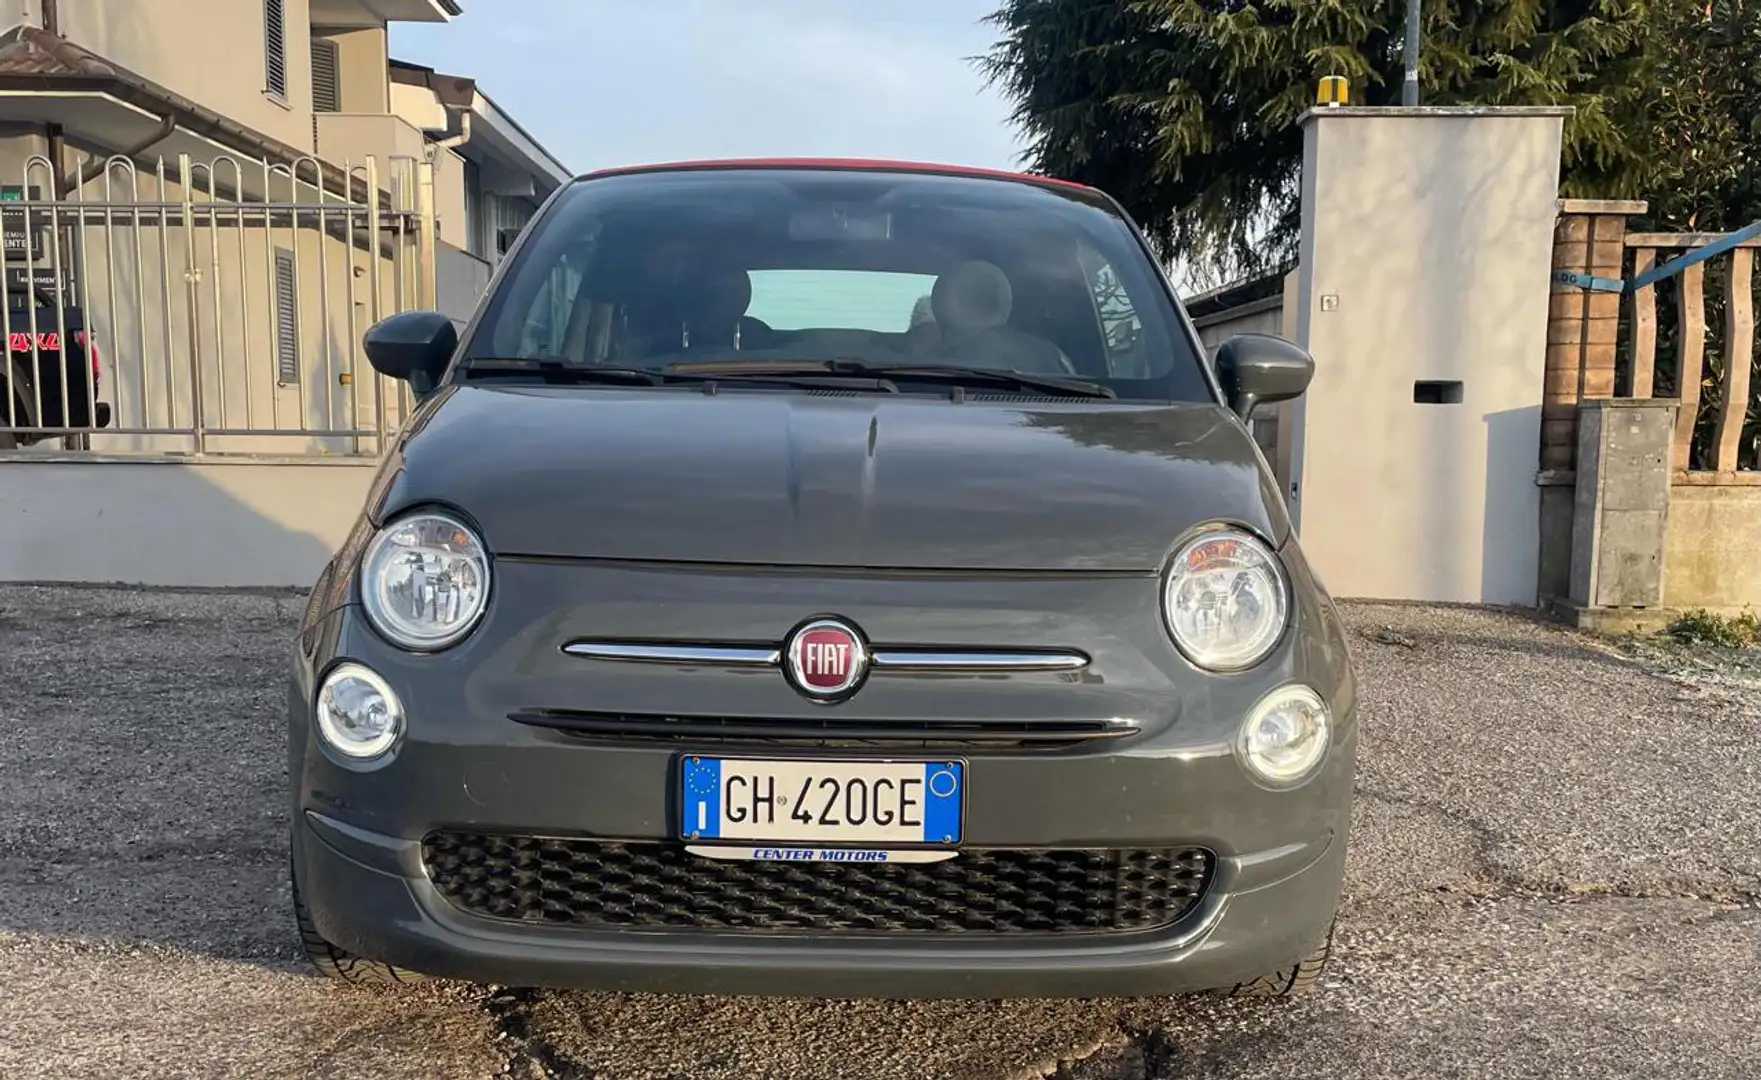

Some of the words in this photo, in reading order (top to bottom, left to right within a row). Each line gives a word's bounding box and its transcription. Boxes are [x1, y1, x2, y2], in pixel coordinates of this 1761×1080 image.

[806, 643, 849, 676] FIAT
[725, 775, 775, 824] GH
[791, 777, 922, 827] 420GE
[753, 848, 814, 860] CENTER
[819, 850, 889, 861] MOTORS
